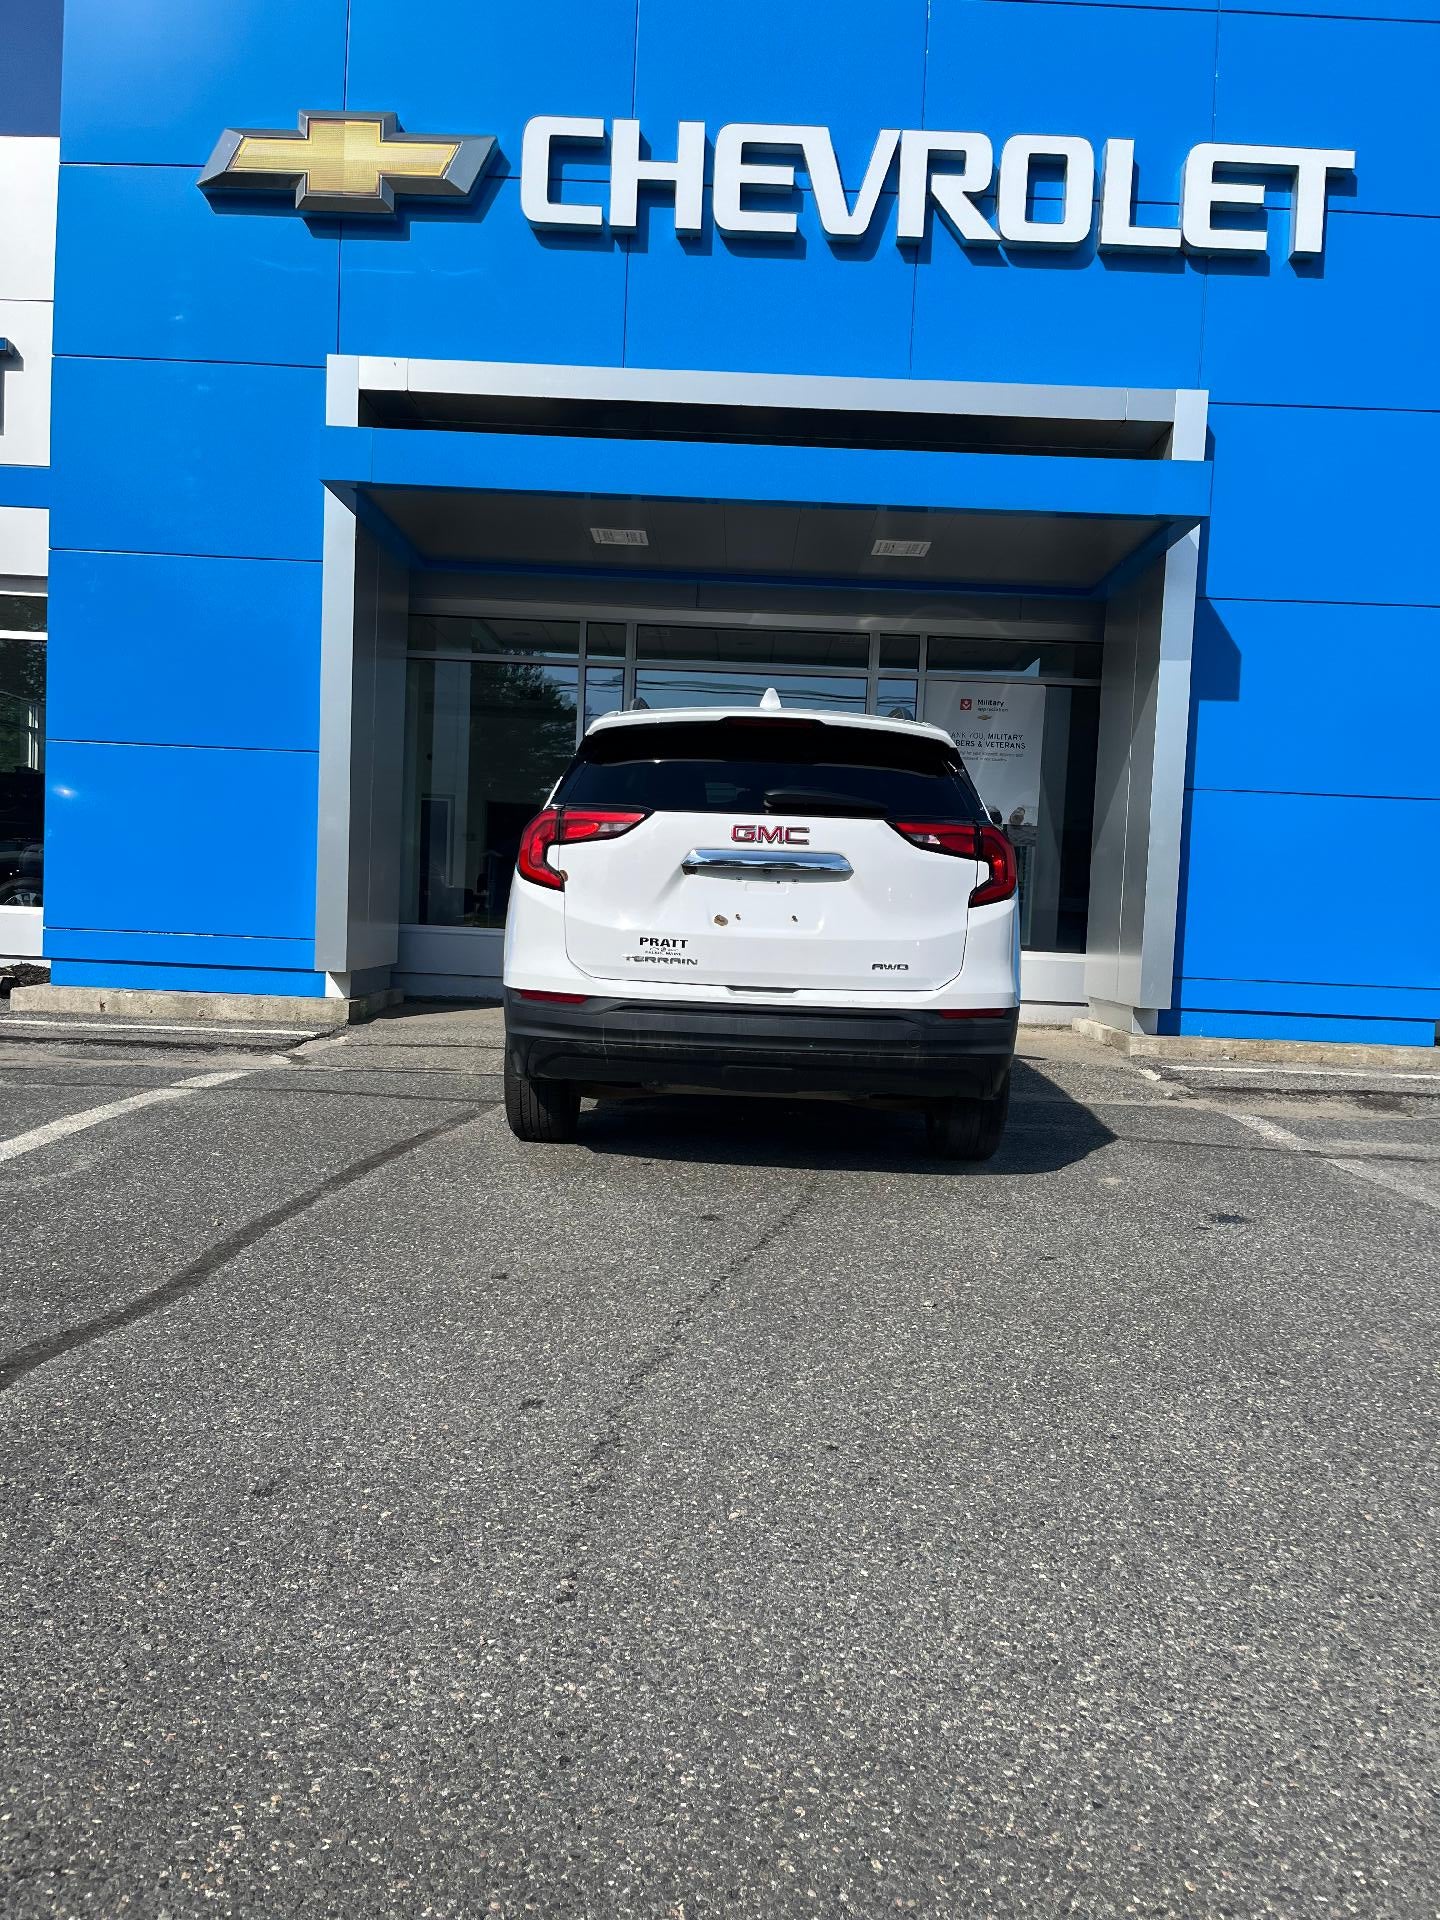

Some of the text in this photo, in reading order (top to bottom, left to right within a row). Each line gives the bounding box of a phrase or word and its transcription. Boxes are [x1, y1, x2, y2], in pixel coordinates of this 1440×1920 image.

[520, 115, 1357, 256] CHEVROLET
[977, 699, 1005, 707] Military
[987, 733, 1024, 741] MILITARY
[977, 741, 983, 749] &
[985, 741, 1026, 749] VETERANS
[730, 824, 810, 845] GMC
[639, 936, 689, 949] PRATT
[624, 955, 698, 966] TERRAIN
